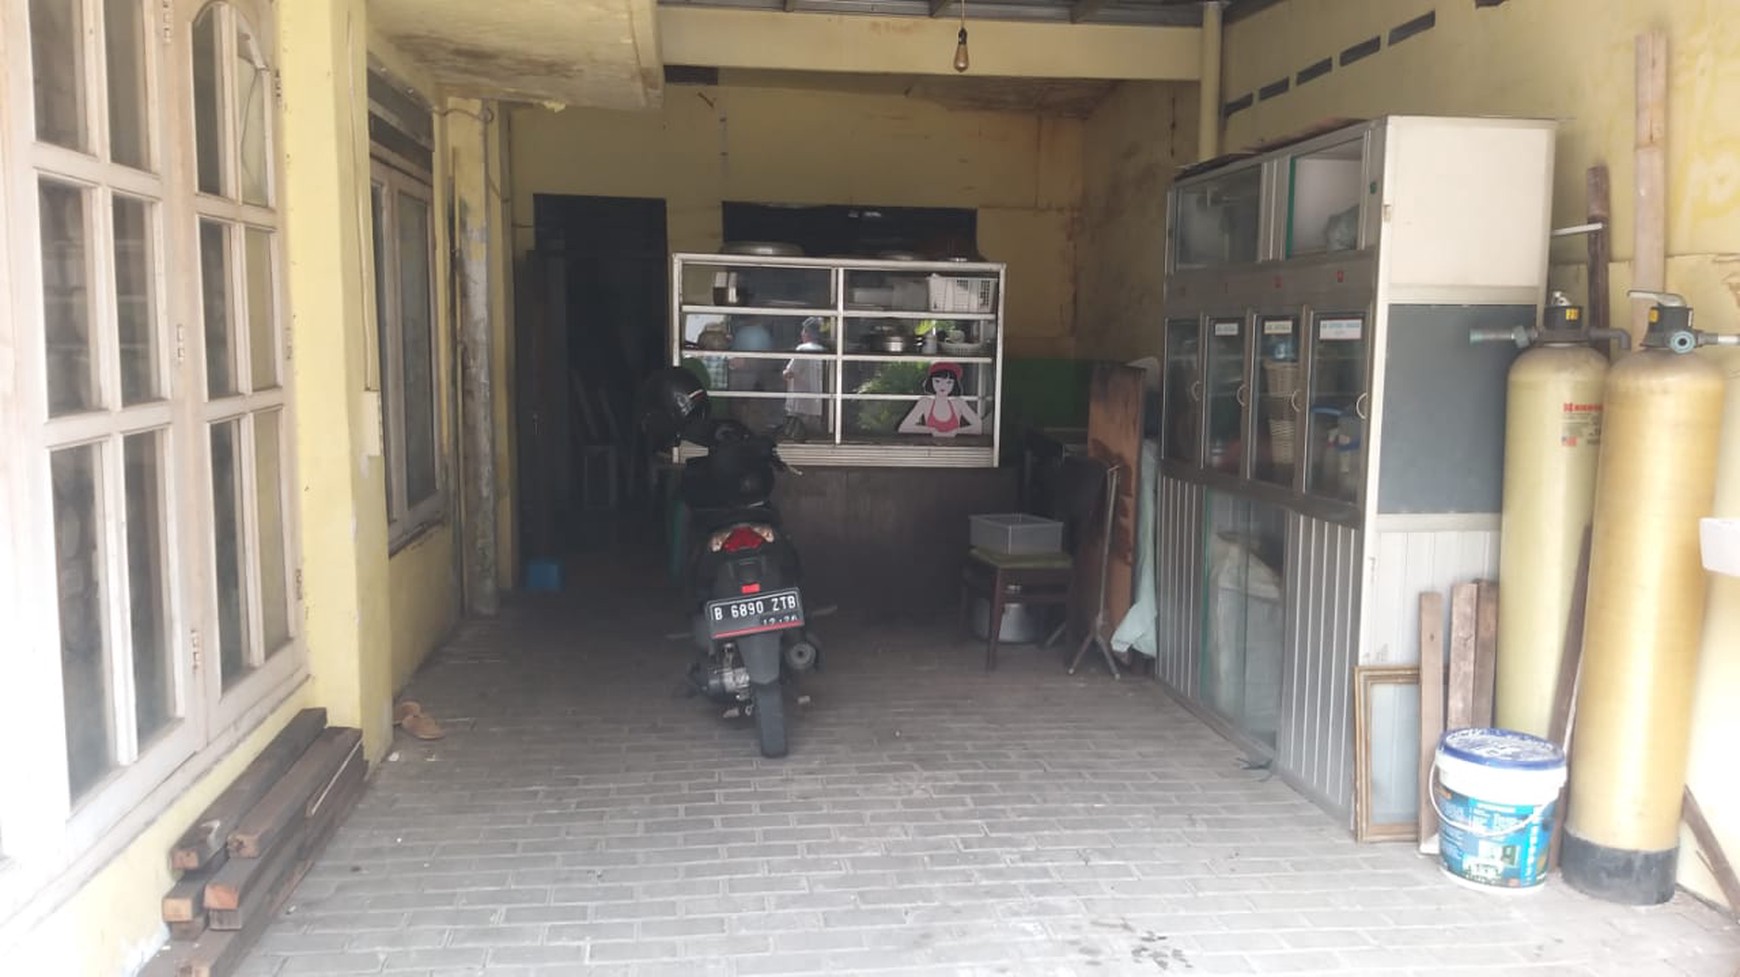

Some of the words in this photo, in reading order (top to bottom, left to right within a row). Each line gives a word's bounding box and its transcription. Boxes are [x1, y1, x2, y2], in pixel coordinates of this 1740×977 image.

[714, 607, 723, 621] B
[730, 601, 764, 618] 6890
[771, 595, 796, 611] ZTB
